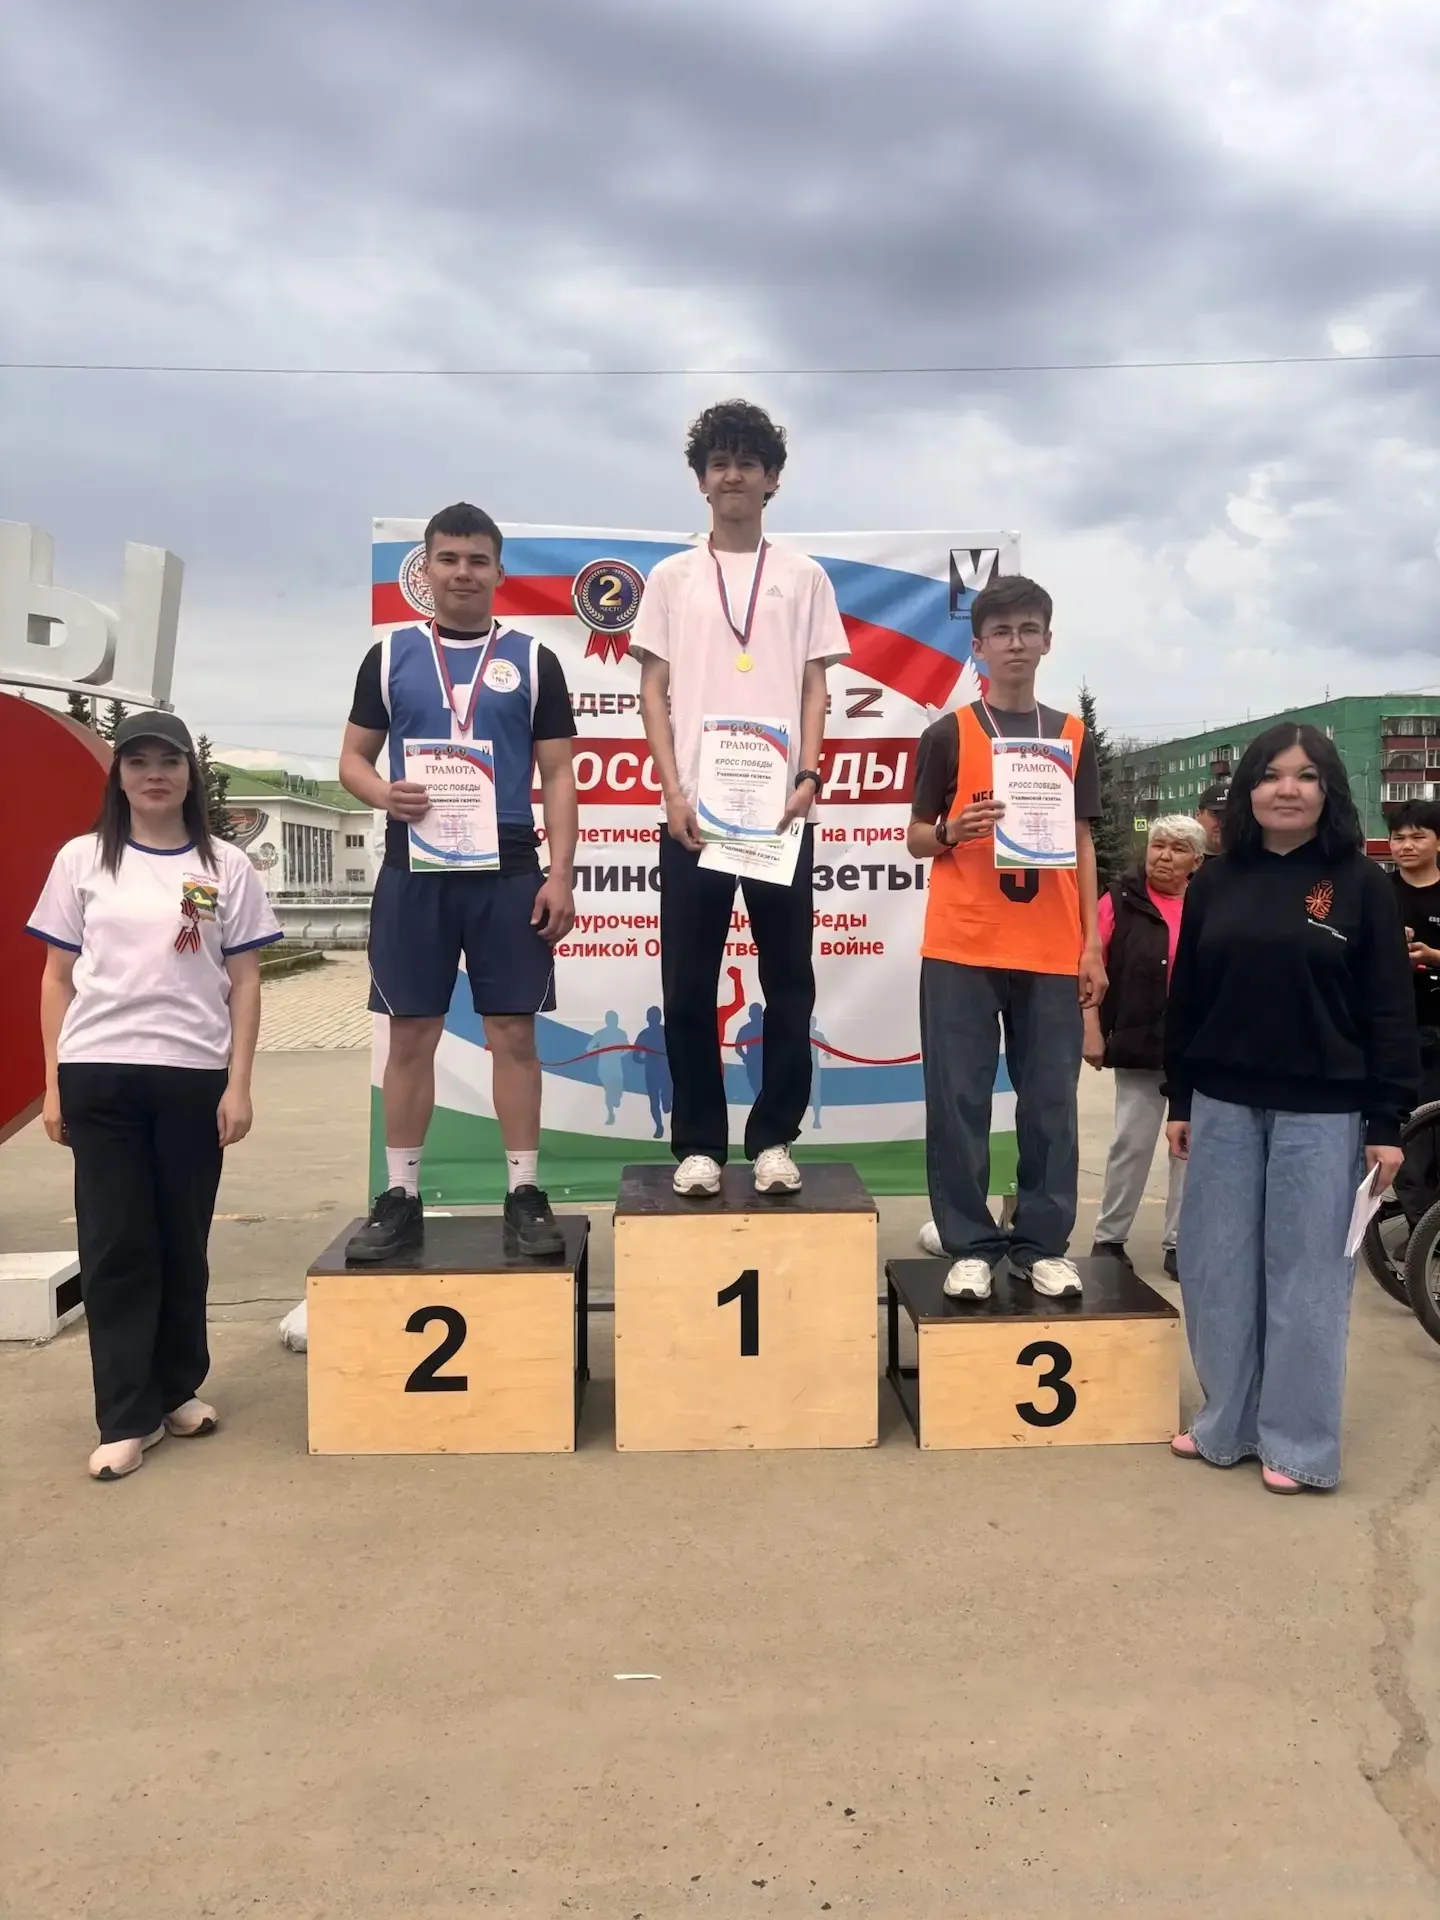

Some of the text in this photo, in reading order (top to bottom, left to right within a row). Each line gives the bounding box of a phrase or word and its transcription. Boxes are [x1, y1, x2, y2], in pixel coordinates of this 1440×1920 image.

[600, 575, 622, 606] 2
[720, 740, 770, 752] ГРАМОТА
[715, 758, 773, 768] КРОСС ПОБЕДЫ
[1011, 763, 1058, 773] ГРАМОТА
[425, 765, 476, 775] ГРАМОТА
[449, 783, 481, 792] ПОБЕДЫ
[1008, 781, 1062, 790] КРОСС ПОБЕДЫ
[821, 827, 847, 842] на
[552, 938, 638, 957] еликой
[820, 937, 884, 955] войне
[717, 1269, 759, 1357] 1
[404, 1305, 468, 1393] 2
[1015, 1340, 1077, 1427] 3
